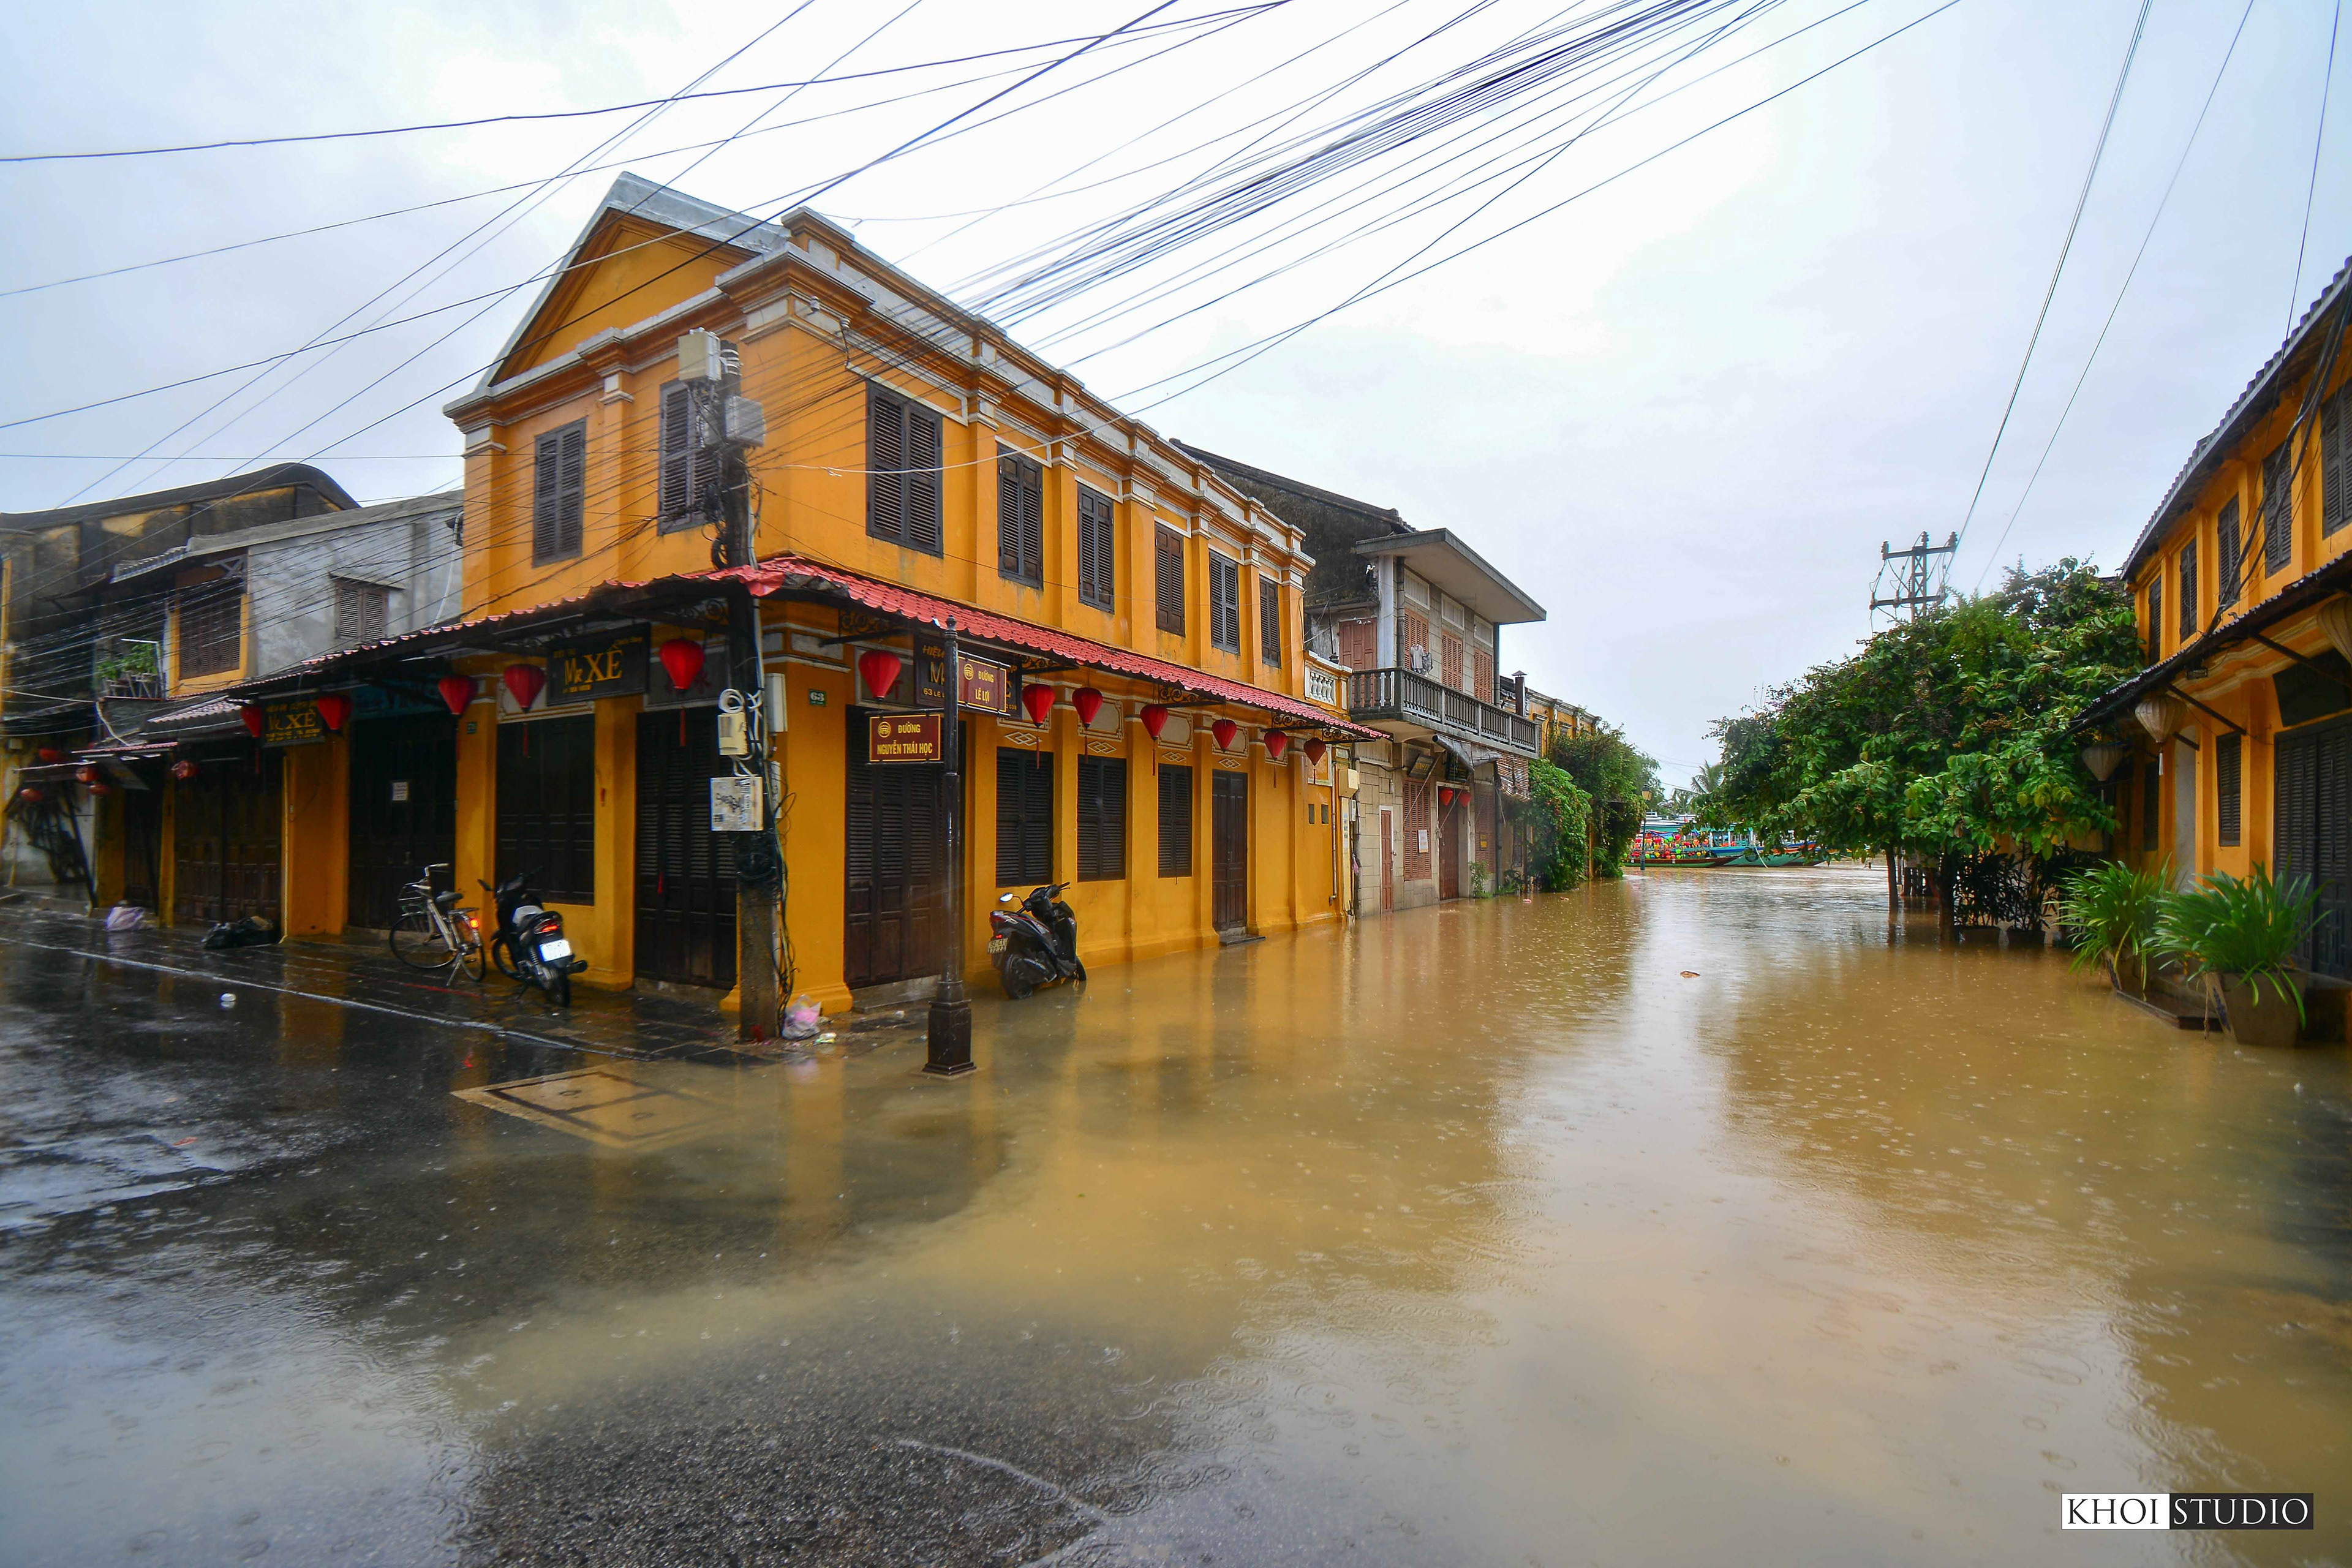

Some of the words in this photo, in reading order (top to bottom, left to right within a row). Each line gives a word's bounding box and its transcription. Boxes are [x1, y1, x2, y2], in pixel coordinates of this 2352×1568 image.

[978, 669, 994, 683] ĐƯỜNG
[810, 692, 824, 701] 63
[923, 687, 933, 696] 63
[975, 687, 981, 700] LÊ
[898, 721, 921, 734] ĐƯỜNG
[877, 740, 902, 755] NGUYỄN
[902, 741, 918, 754] THÁI
[919, 743, 933, 756] HỌC
